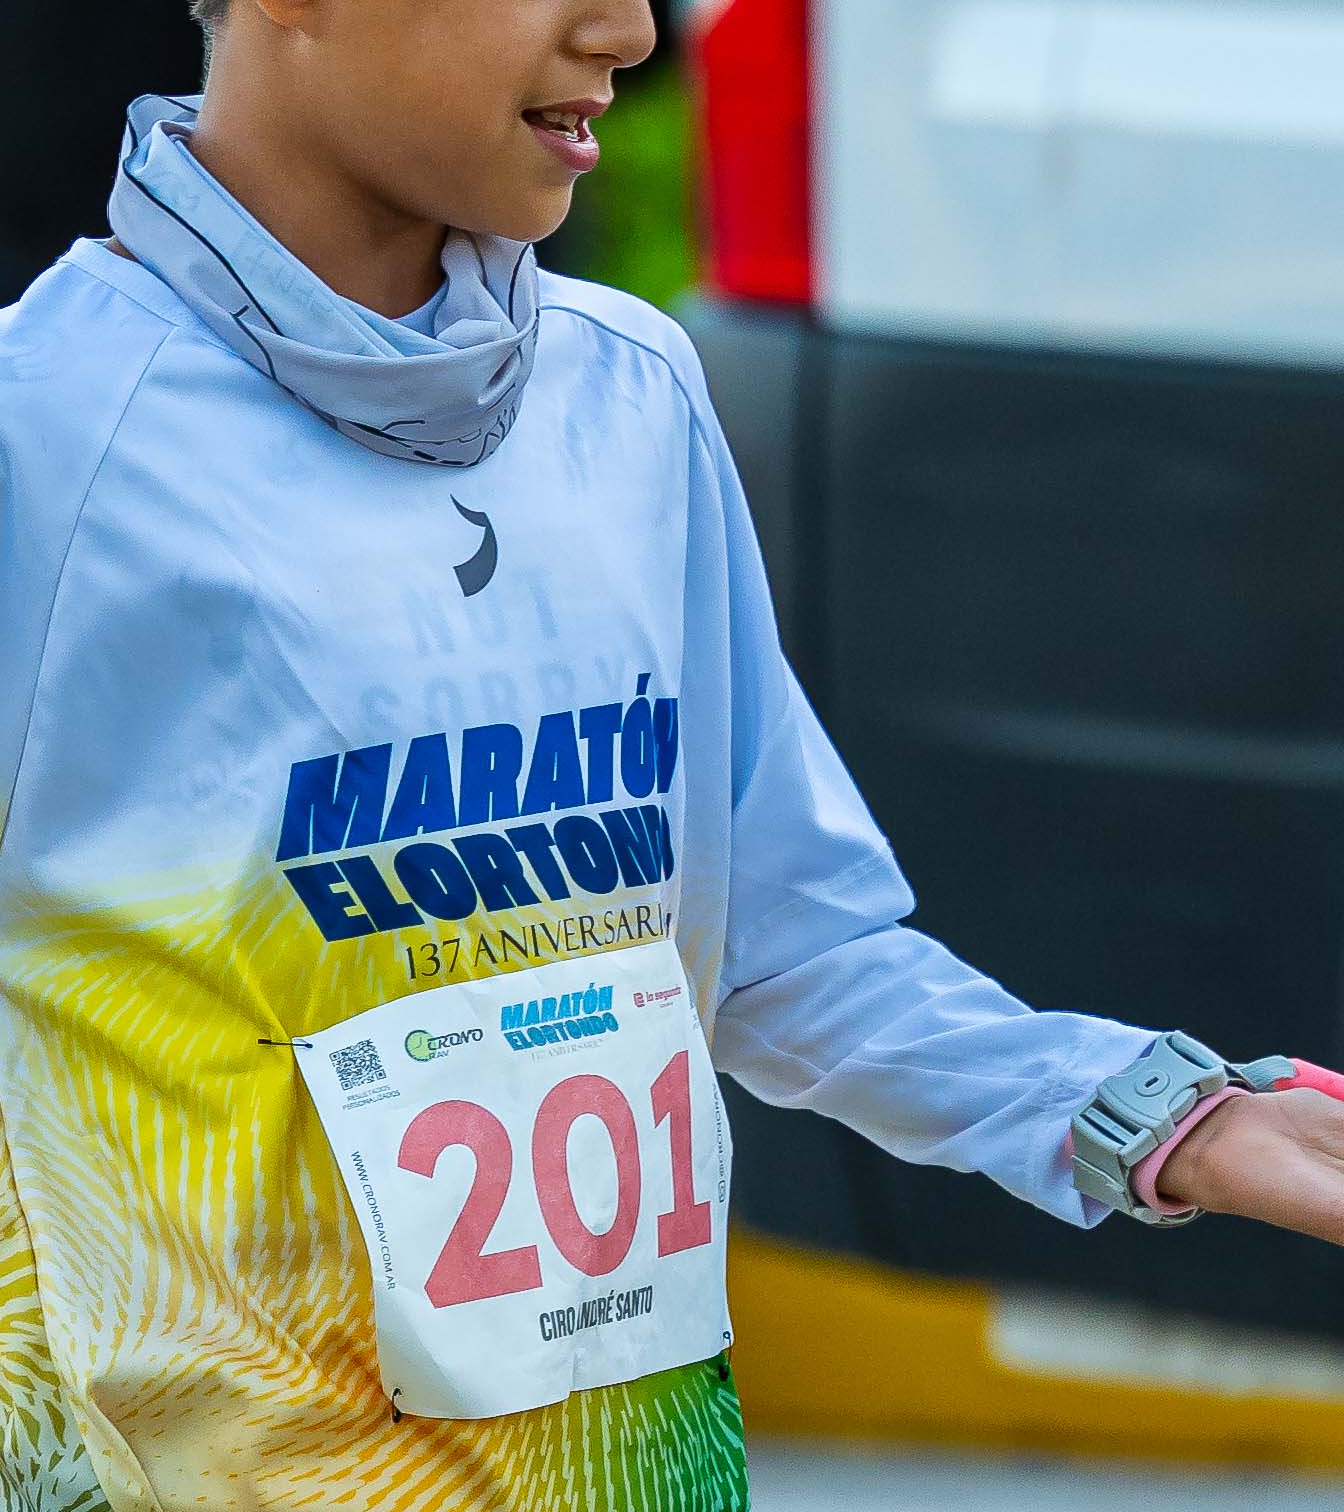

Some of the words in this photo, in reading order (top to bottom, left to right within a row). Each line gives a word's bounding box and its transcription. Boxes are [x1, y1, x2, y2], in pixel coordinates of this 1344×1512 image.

[405, 937, 462, 980] 137
[473, 902, 672, 968] ANIVERSARI
[500, 981, 614, 1031] MARATÓN
[505, 1011, 619, 1052] ELORTONDO
[427, 1028, 483, 1051] CRONO
[428, 1049, 449, 1061] RAV
[397, 1049, 713, 1309] 201
[350, 1150, 397, 1291] WWW.CRONORAV.COM.AR
[539, 1306, 576, 1342] CIRO
[616, 1285, 654, 1321] SANTO
